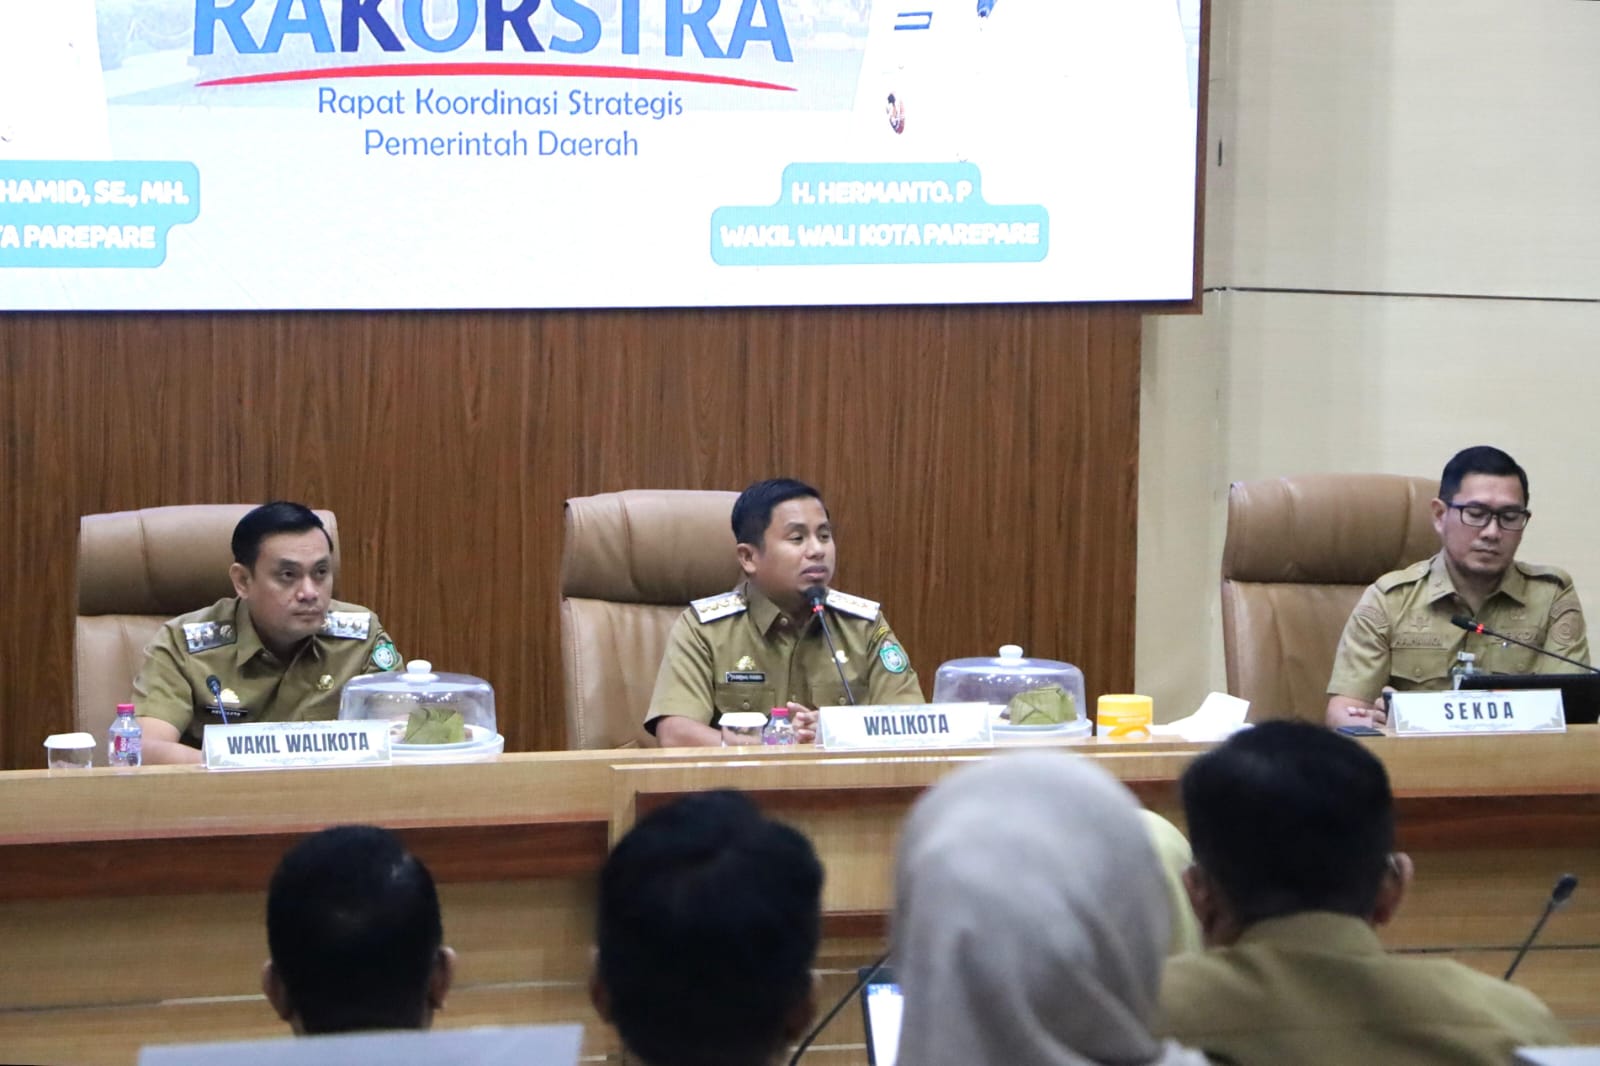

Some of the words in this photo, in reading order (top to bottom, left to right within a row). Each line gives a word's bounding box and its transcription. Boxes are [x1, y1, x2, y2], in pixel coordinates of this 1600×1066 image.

[194, 0, 794, 63] RAKORSTRA
[318, 87, 405, 119] Rapat
[416, 88, 558, 115] Koordinasi
[569, 89, 683, 119] Strategis
[365, 129, 528, 156] Pemerintah
[538, 130, 639, 156] Daerah
[792, 181, 815, 204] H.
[956, 180, 972, 204] P
[23, 224, 156, 249] PAREPARE
[720, 224, 795, 248] WAKIL
[798, 223, 856, 247] WALI
[859, 223, 922, 247] KOTA
[923, 222, 1041, 245] PAREPARE
[1444, 701, 1515, 720] SEKDA
[863, 714, 950, 736] WALIKOTA
[227, 734, 281, 755] WAKIL
[285, 732, 370, 753] WALIKOTA
